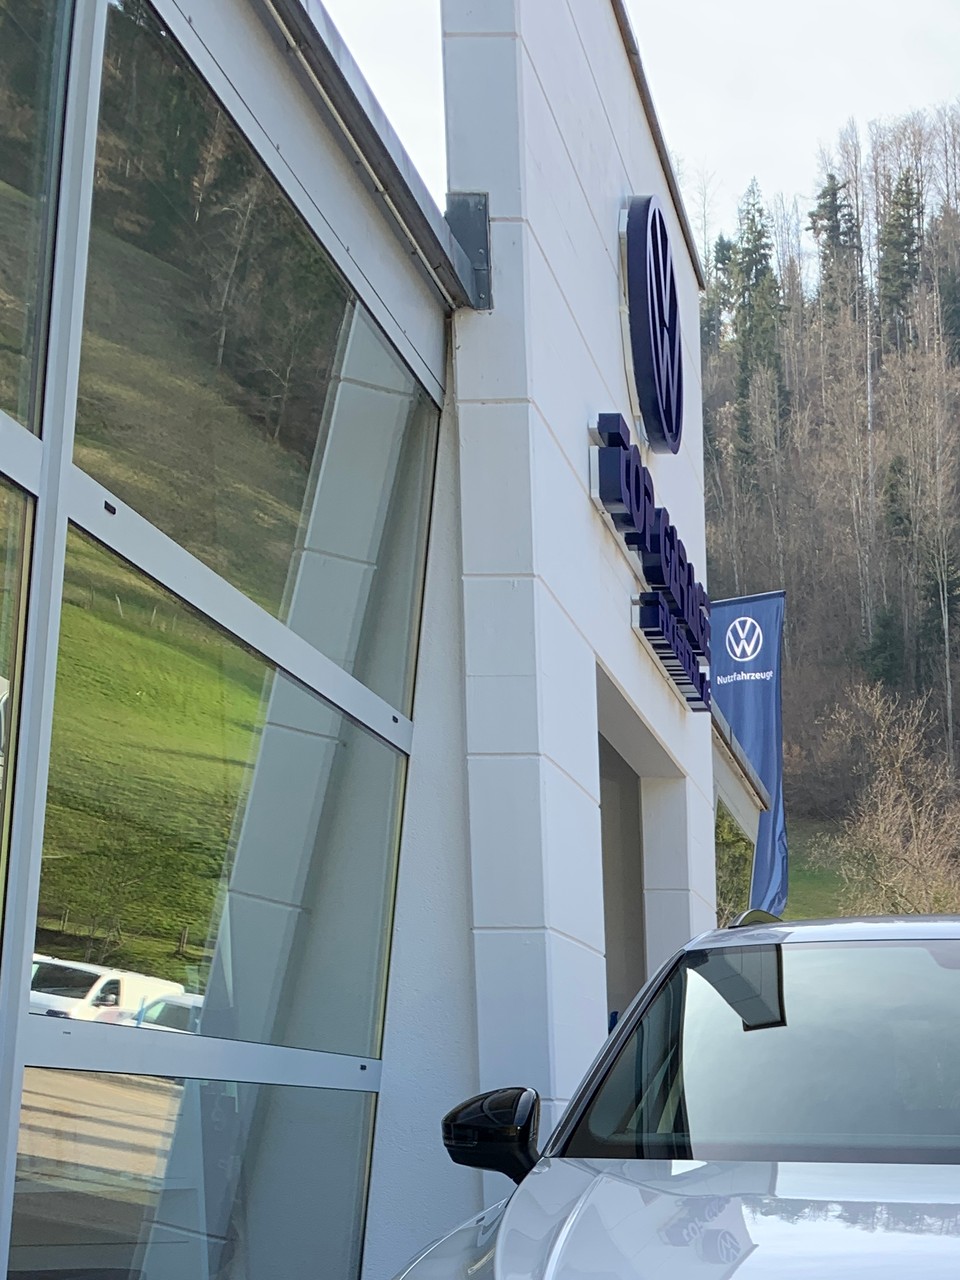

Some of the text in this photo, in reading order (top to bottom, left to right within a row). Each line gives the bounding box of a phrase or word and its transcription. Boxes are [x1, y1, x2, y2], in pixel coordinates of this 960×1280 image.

[600, 412, 656, 552] TOP
[725, 616, 764, 663] VW
[716, 668, 774, 686] Nutzfahrzeuge
